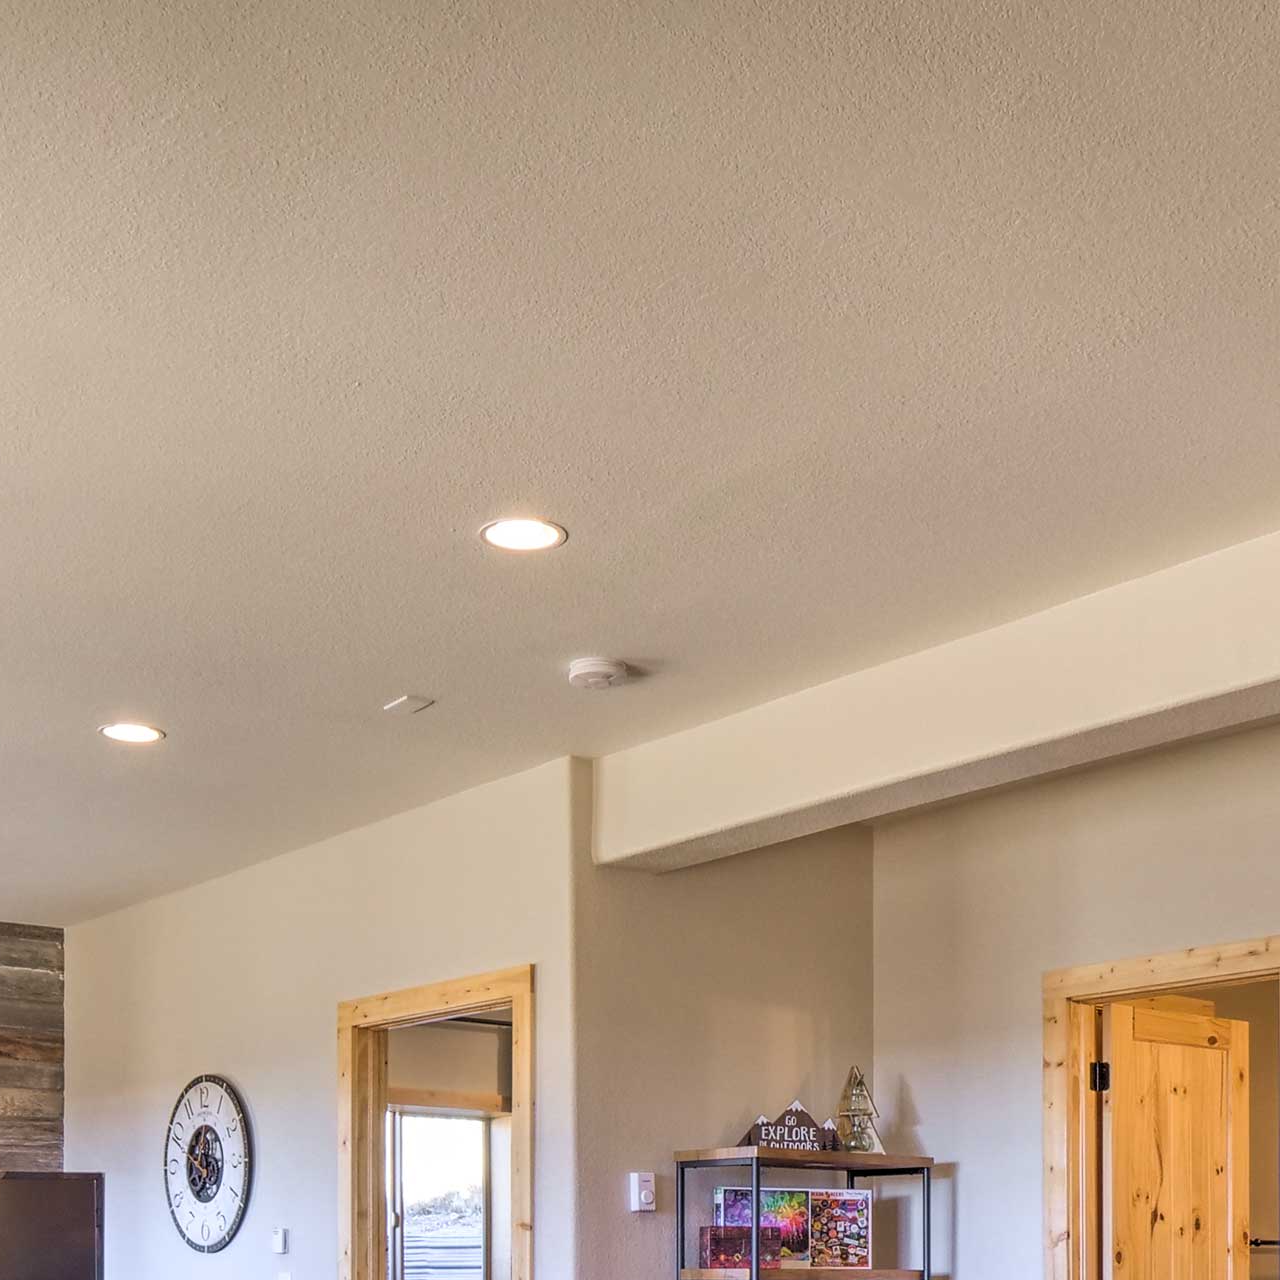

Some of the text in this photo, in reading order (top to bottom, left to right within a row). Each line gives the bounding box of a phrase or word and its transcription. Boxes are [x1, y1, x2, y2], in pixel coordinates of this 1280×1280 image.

[199, 1086, 209, 1109] 12
[216, 1094, 224, 1115] 1
[184, 1098, 194, 1120] 11
[226, 1117, 238, 1138] 2
[785, 1115, 797, 1126] GO
[172, 1121, 184, 1151] 10
[761, 1125, 817, 1142] EXPLORE
[169, 1158, 179, 1175] 9
[231, 1152, 243, 1168] 3
[185, 1210, 195, 1231] 7
[201, 1219, 210, 1241] 6
[216, 1210, 227, 1231] 5
